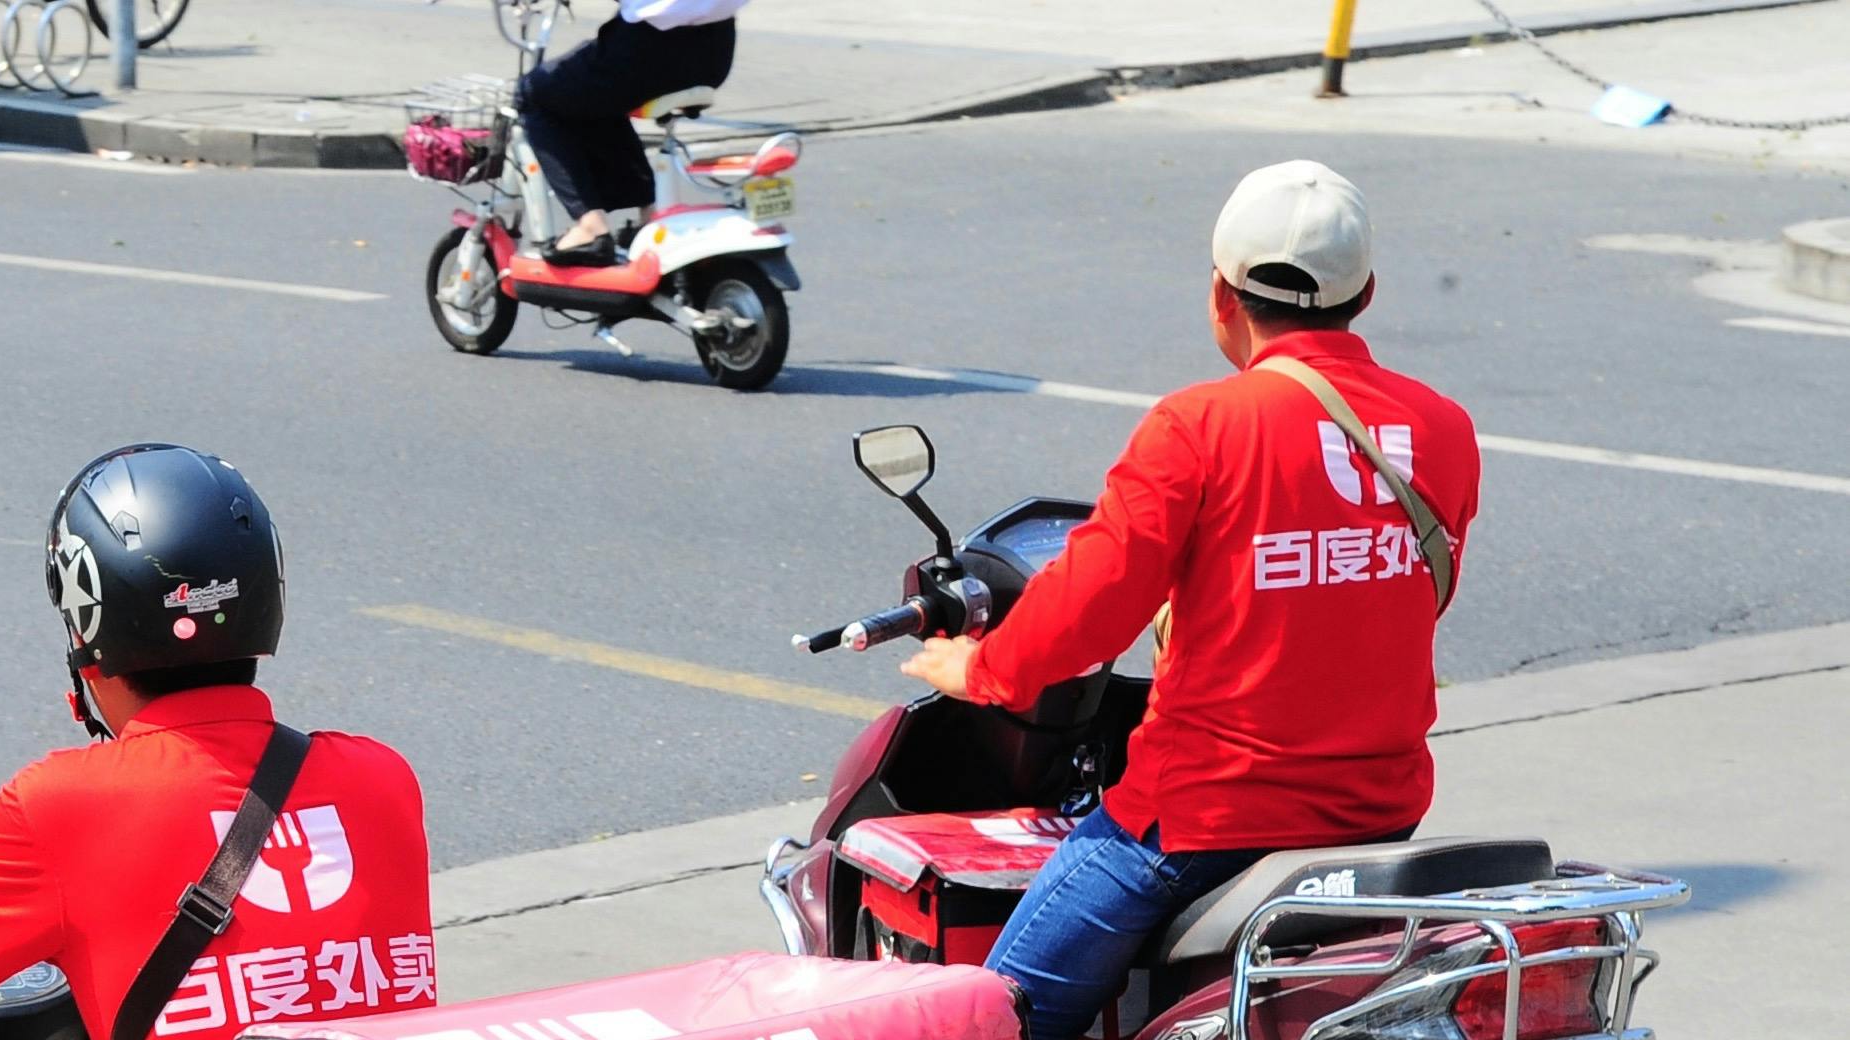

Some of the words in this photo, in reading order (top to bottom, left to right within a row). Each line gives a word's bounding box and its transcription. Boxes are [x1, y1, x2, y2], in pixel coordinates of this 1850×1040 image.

[1253, 524, 1459, 590] 百度外
[154, 933, 436, 1036] 百度外卖
